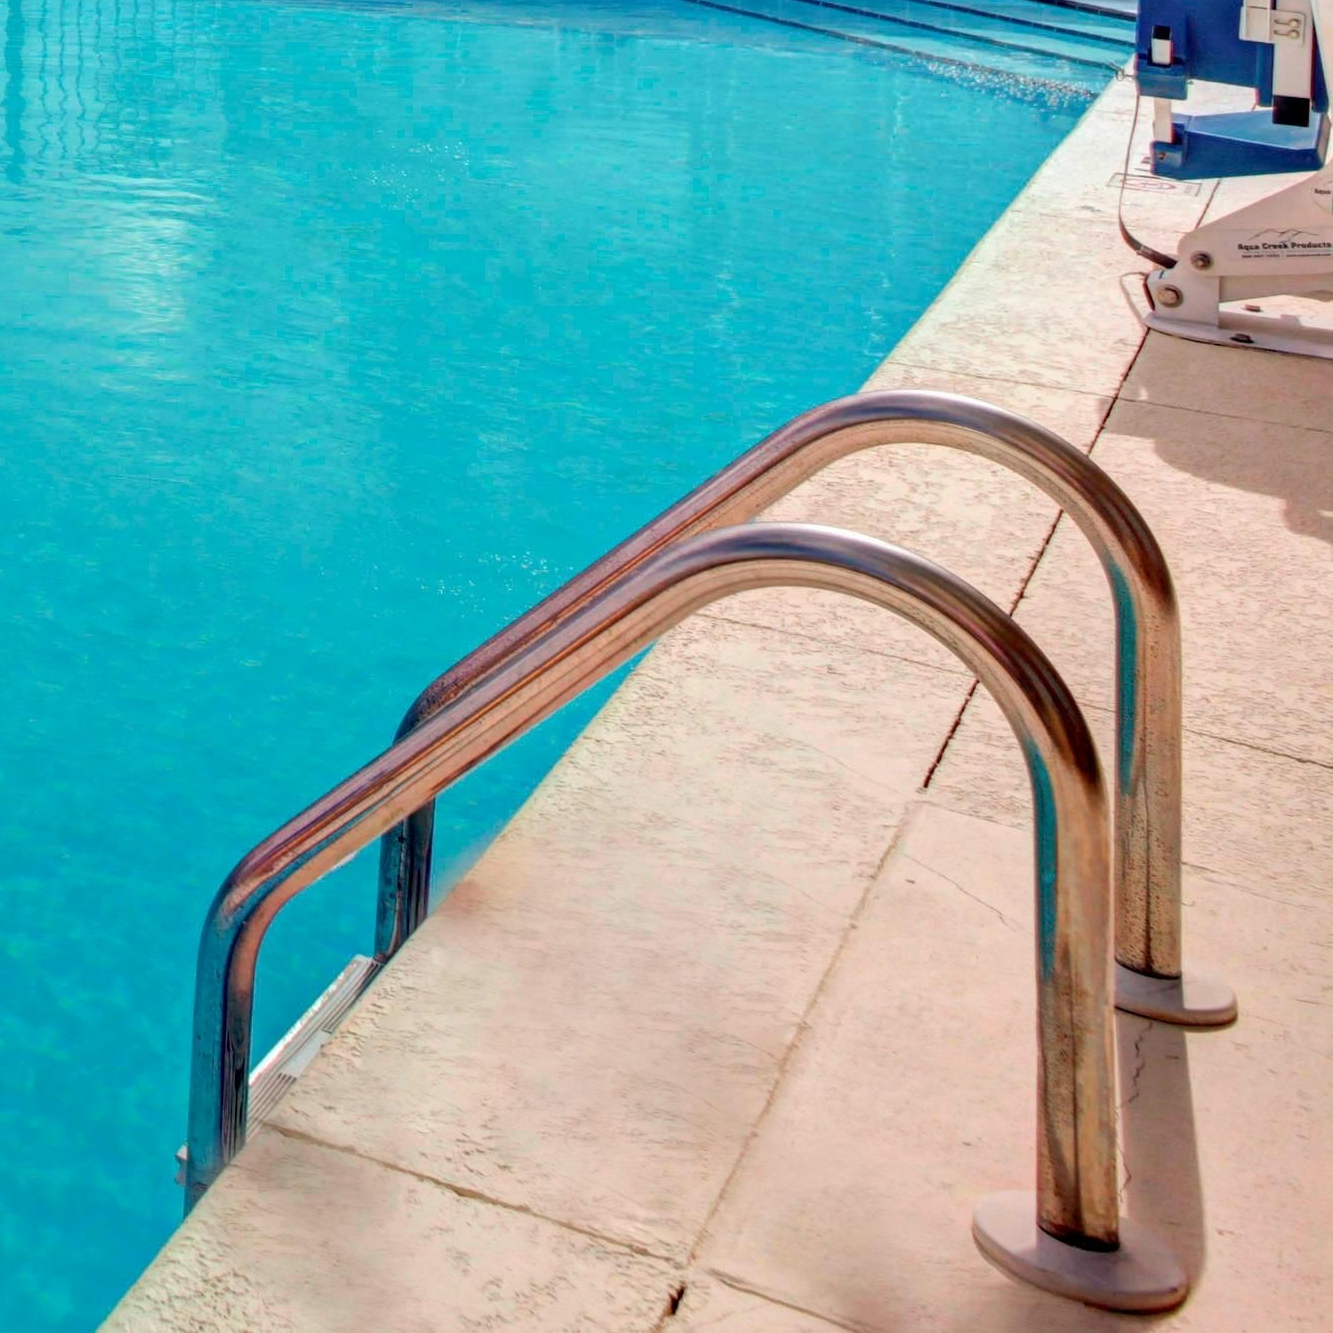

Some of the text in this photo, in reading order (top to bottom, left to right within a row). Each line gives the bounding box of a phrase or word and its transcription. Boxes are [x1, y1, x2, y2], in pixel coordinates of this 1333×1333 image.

[1237, 241, 1333, 252] Aqua Creek Products
